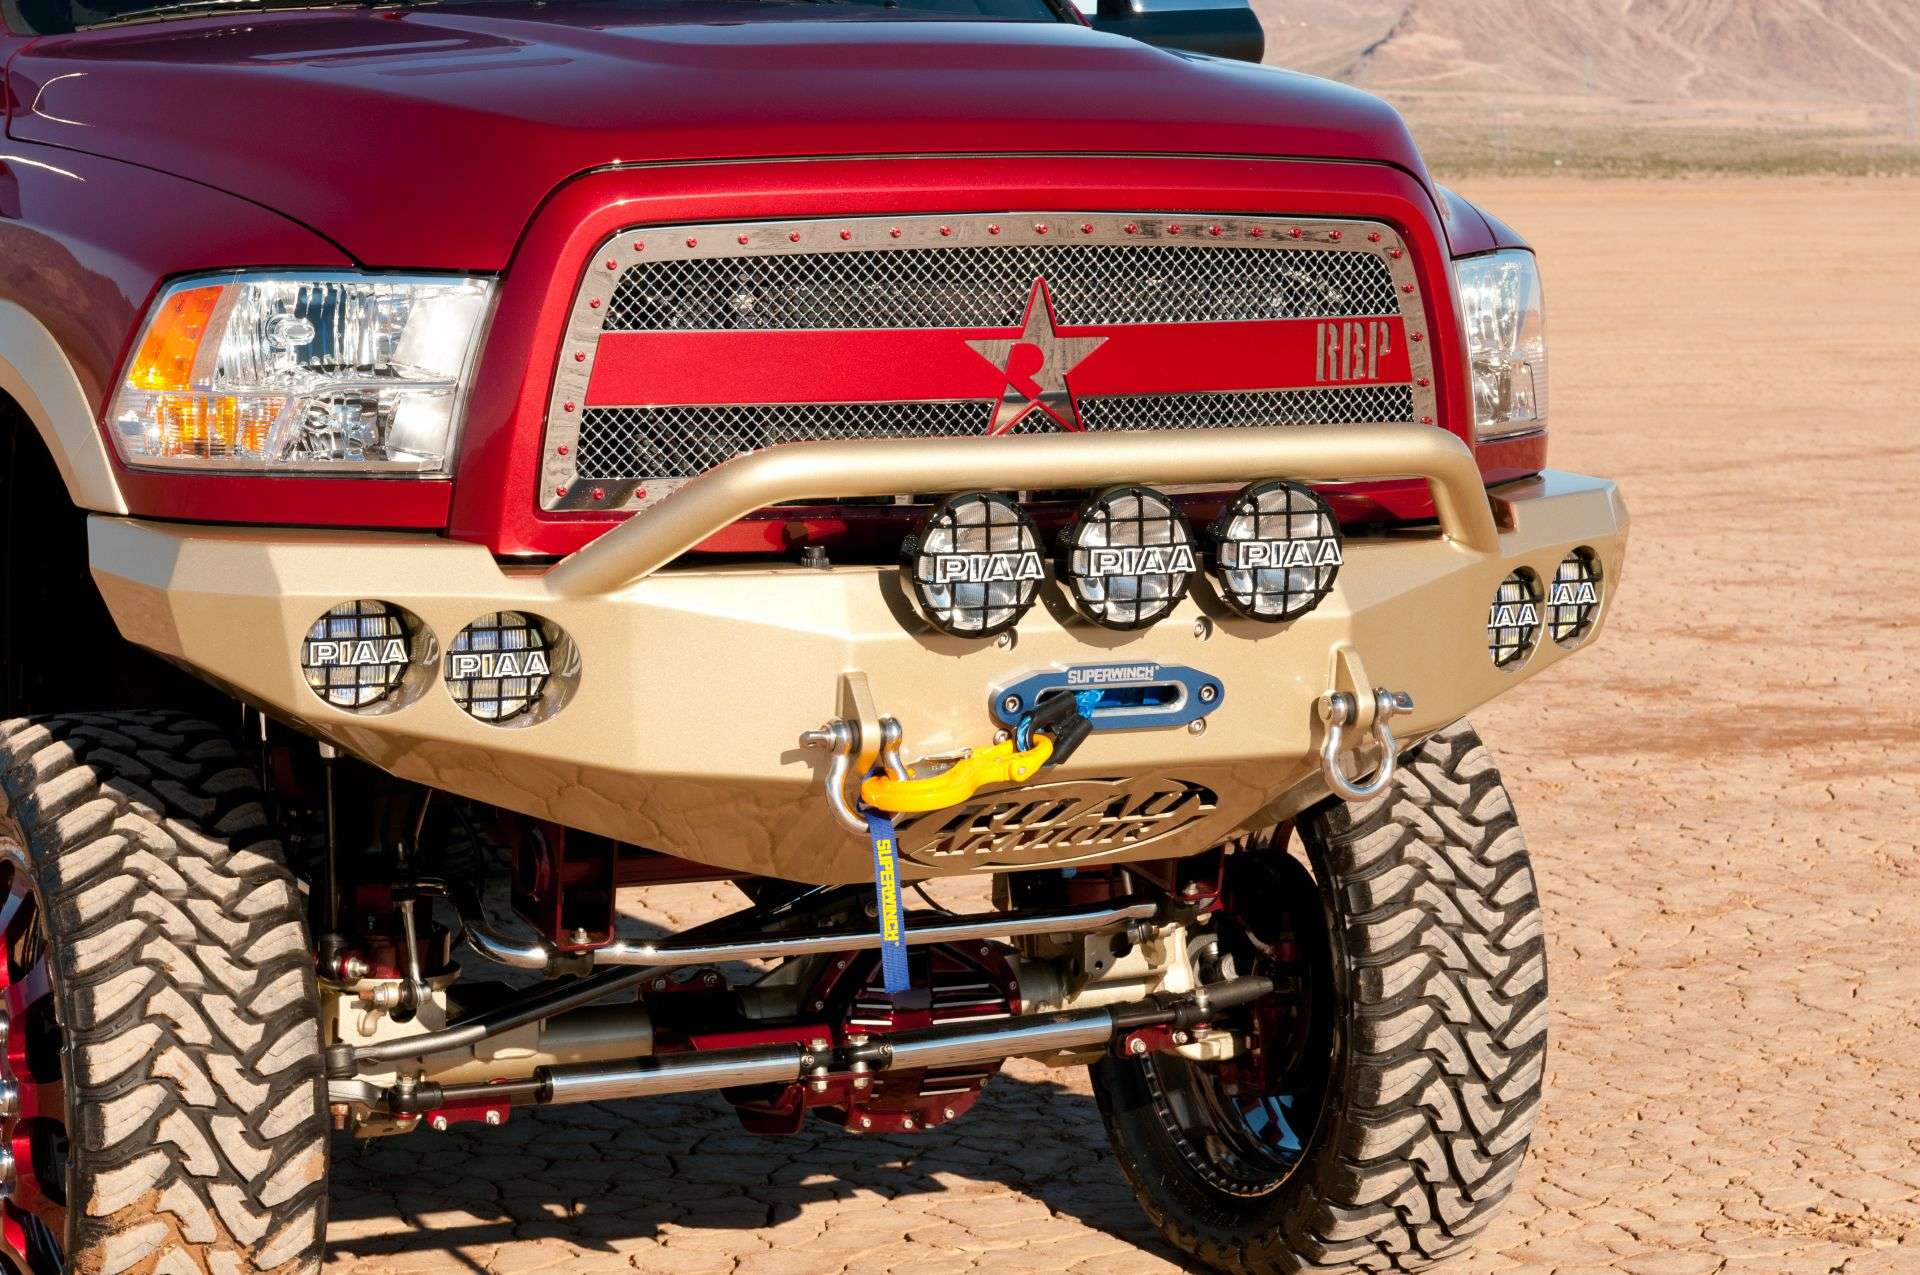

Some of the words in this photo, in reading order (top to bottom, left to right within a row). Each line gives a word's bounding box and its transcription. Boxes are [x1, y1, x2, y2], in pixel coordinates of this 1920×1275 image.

[1316, 321, 1391, 382] RBP
[935, 551, 1047, 584] PIAA
[1090, 544, 1197, 578] PIAA
[1238, 538, 1344, 570] PIAA
[309, 638, 409, 667] PIAA
[452, 650, 550, 679] PIAA
[1067, 665, 1155, 684] SUPERWINCH
[876, 839, 900, 941] SUPERWINCH
